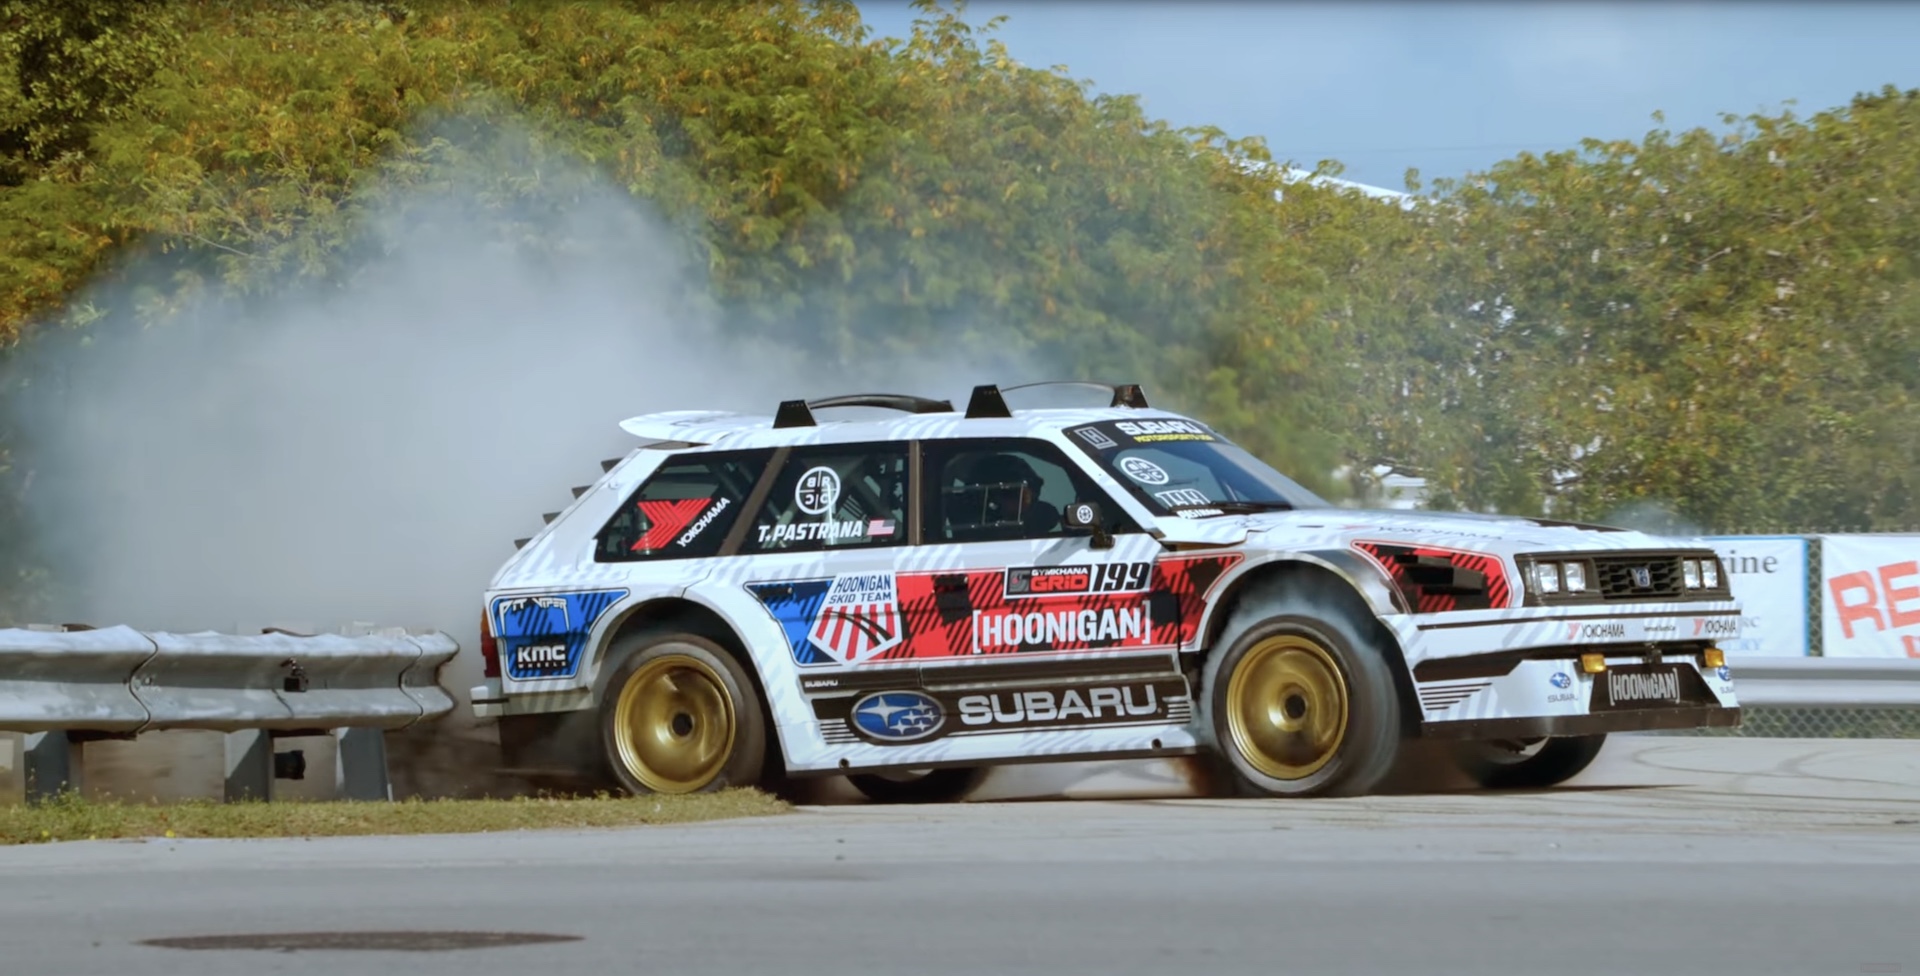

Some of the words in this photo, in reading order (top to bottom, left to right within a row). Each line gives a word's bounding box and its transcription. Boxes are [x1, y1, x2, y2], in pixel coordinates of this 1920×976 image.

[1115, 421, 1204, 436] SUBARU
[676, 497, 731, 547] YOKOHAMA
[1031, 567, 1089, 577] GYMKHANA
[1092, 562, 1150, 592] 199
[834, 574, 891, 594] HOONIGAN
[828, 593, 856, 604] SKID
[860, 591, 892, 602] TEAM
[1582, 624, 1625, 638] YOKOHAMA
[517, 644, 566, 662] KMC
[805, 680, 838, 688] SUBARU
[958, 684, 1157, 725] SUBARU
